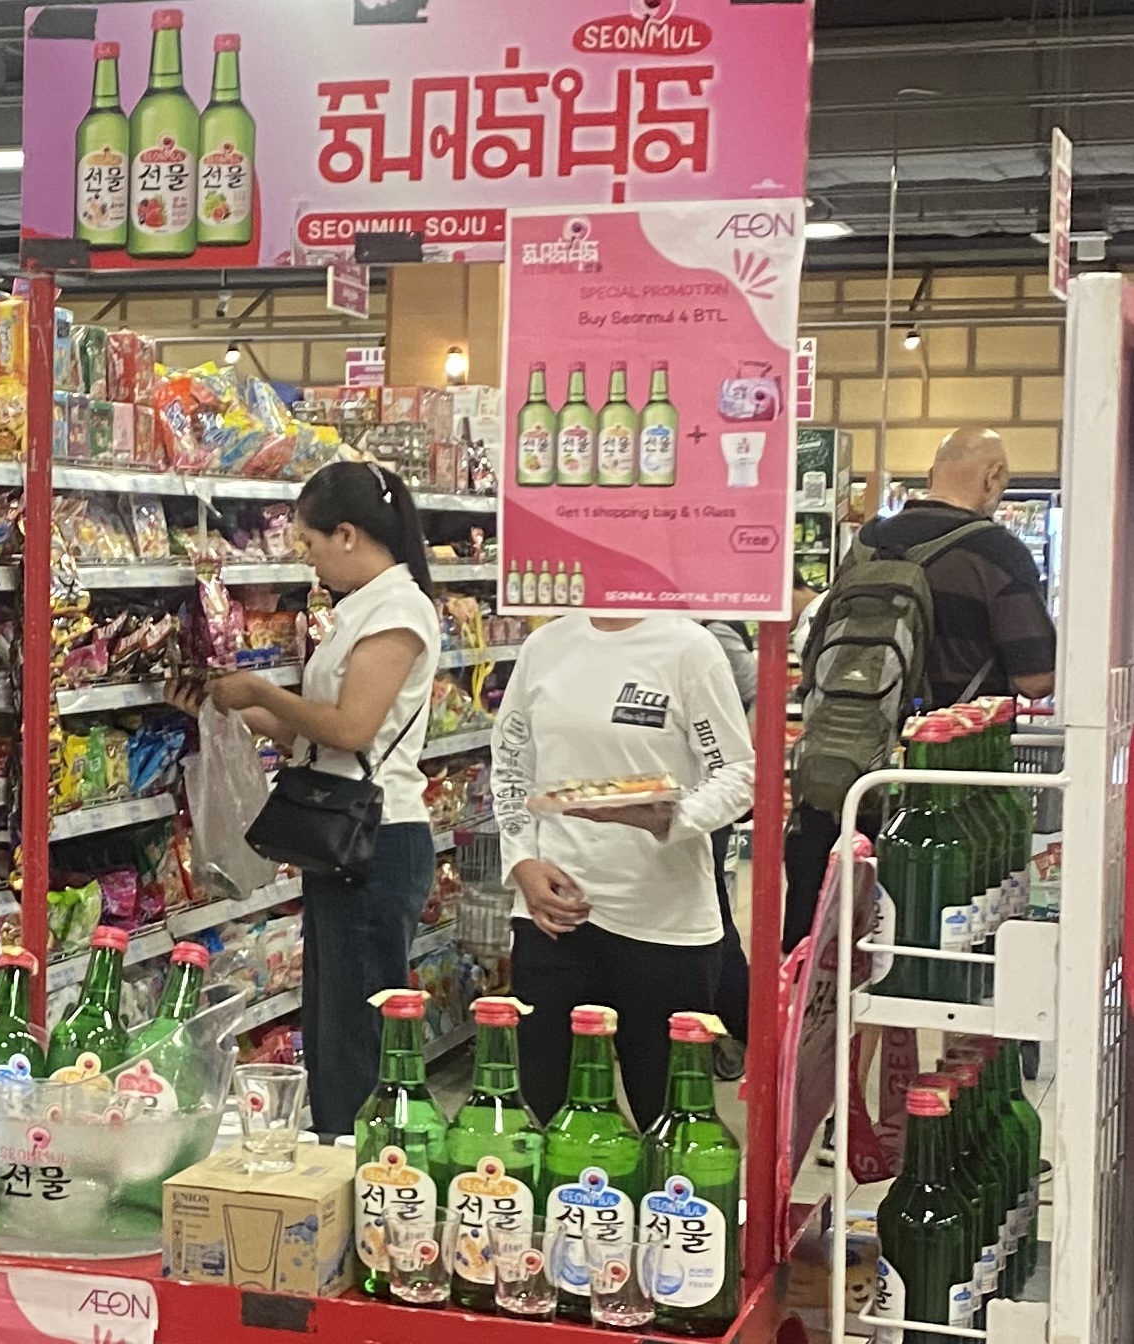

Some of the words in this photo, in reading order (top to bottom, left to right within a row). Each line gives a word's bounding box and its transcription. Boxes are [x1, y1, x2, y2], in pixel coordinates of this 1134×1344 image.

[581, 22, 702, 50] SEONMUL
[137, 163, 190, 192] 선물
[201, 164, 247, 190] 선물
[424, 215, 488, 237] SOJU
[579, 284, 639, 300] SPECIAL
[641, 282, 730, 298] PROMOTION
[578, 311, 607, 327] Buy
[610, 310, 674, 325] Seonmul
[694, 308, 728, 323] BTL
[556, 506, 580, 518] Get
[591, 506, 649, 521] shopping
[653, 506, 677, 521] bag
[738, 532, 770, 546] Free
[0, 1163, 72, 1201] 선물
[361, 1183, 426, 1220] 선물
[457, 1194, 523, 1231] 선물
[556, 1205, 625, 1243] 선물
[646, 1213, 714, 1254] 선물
